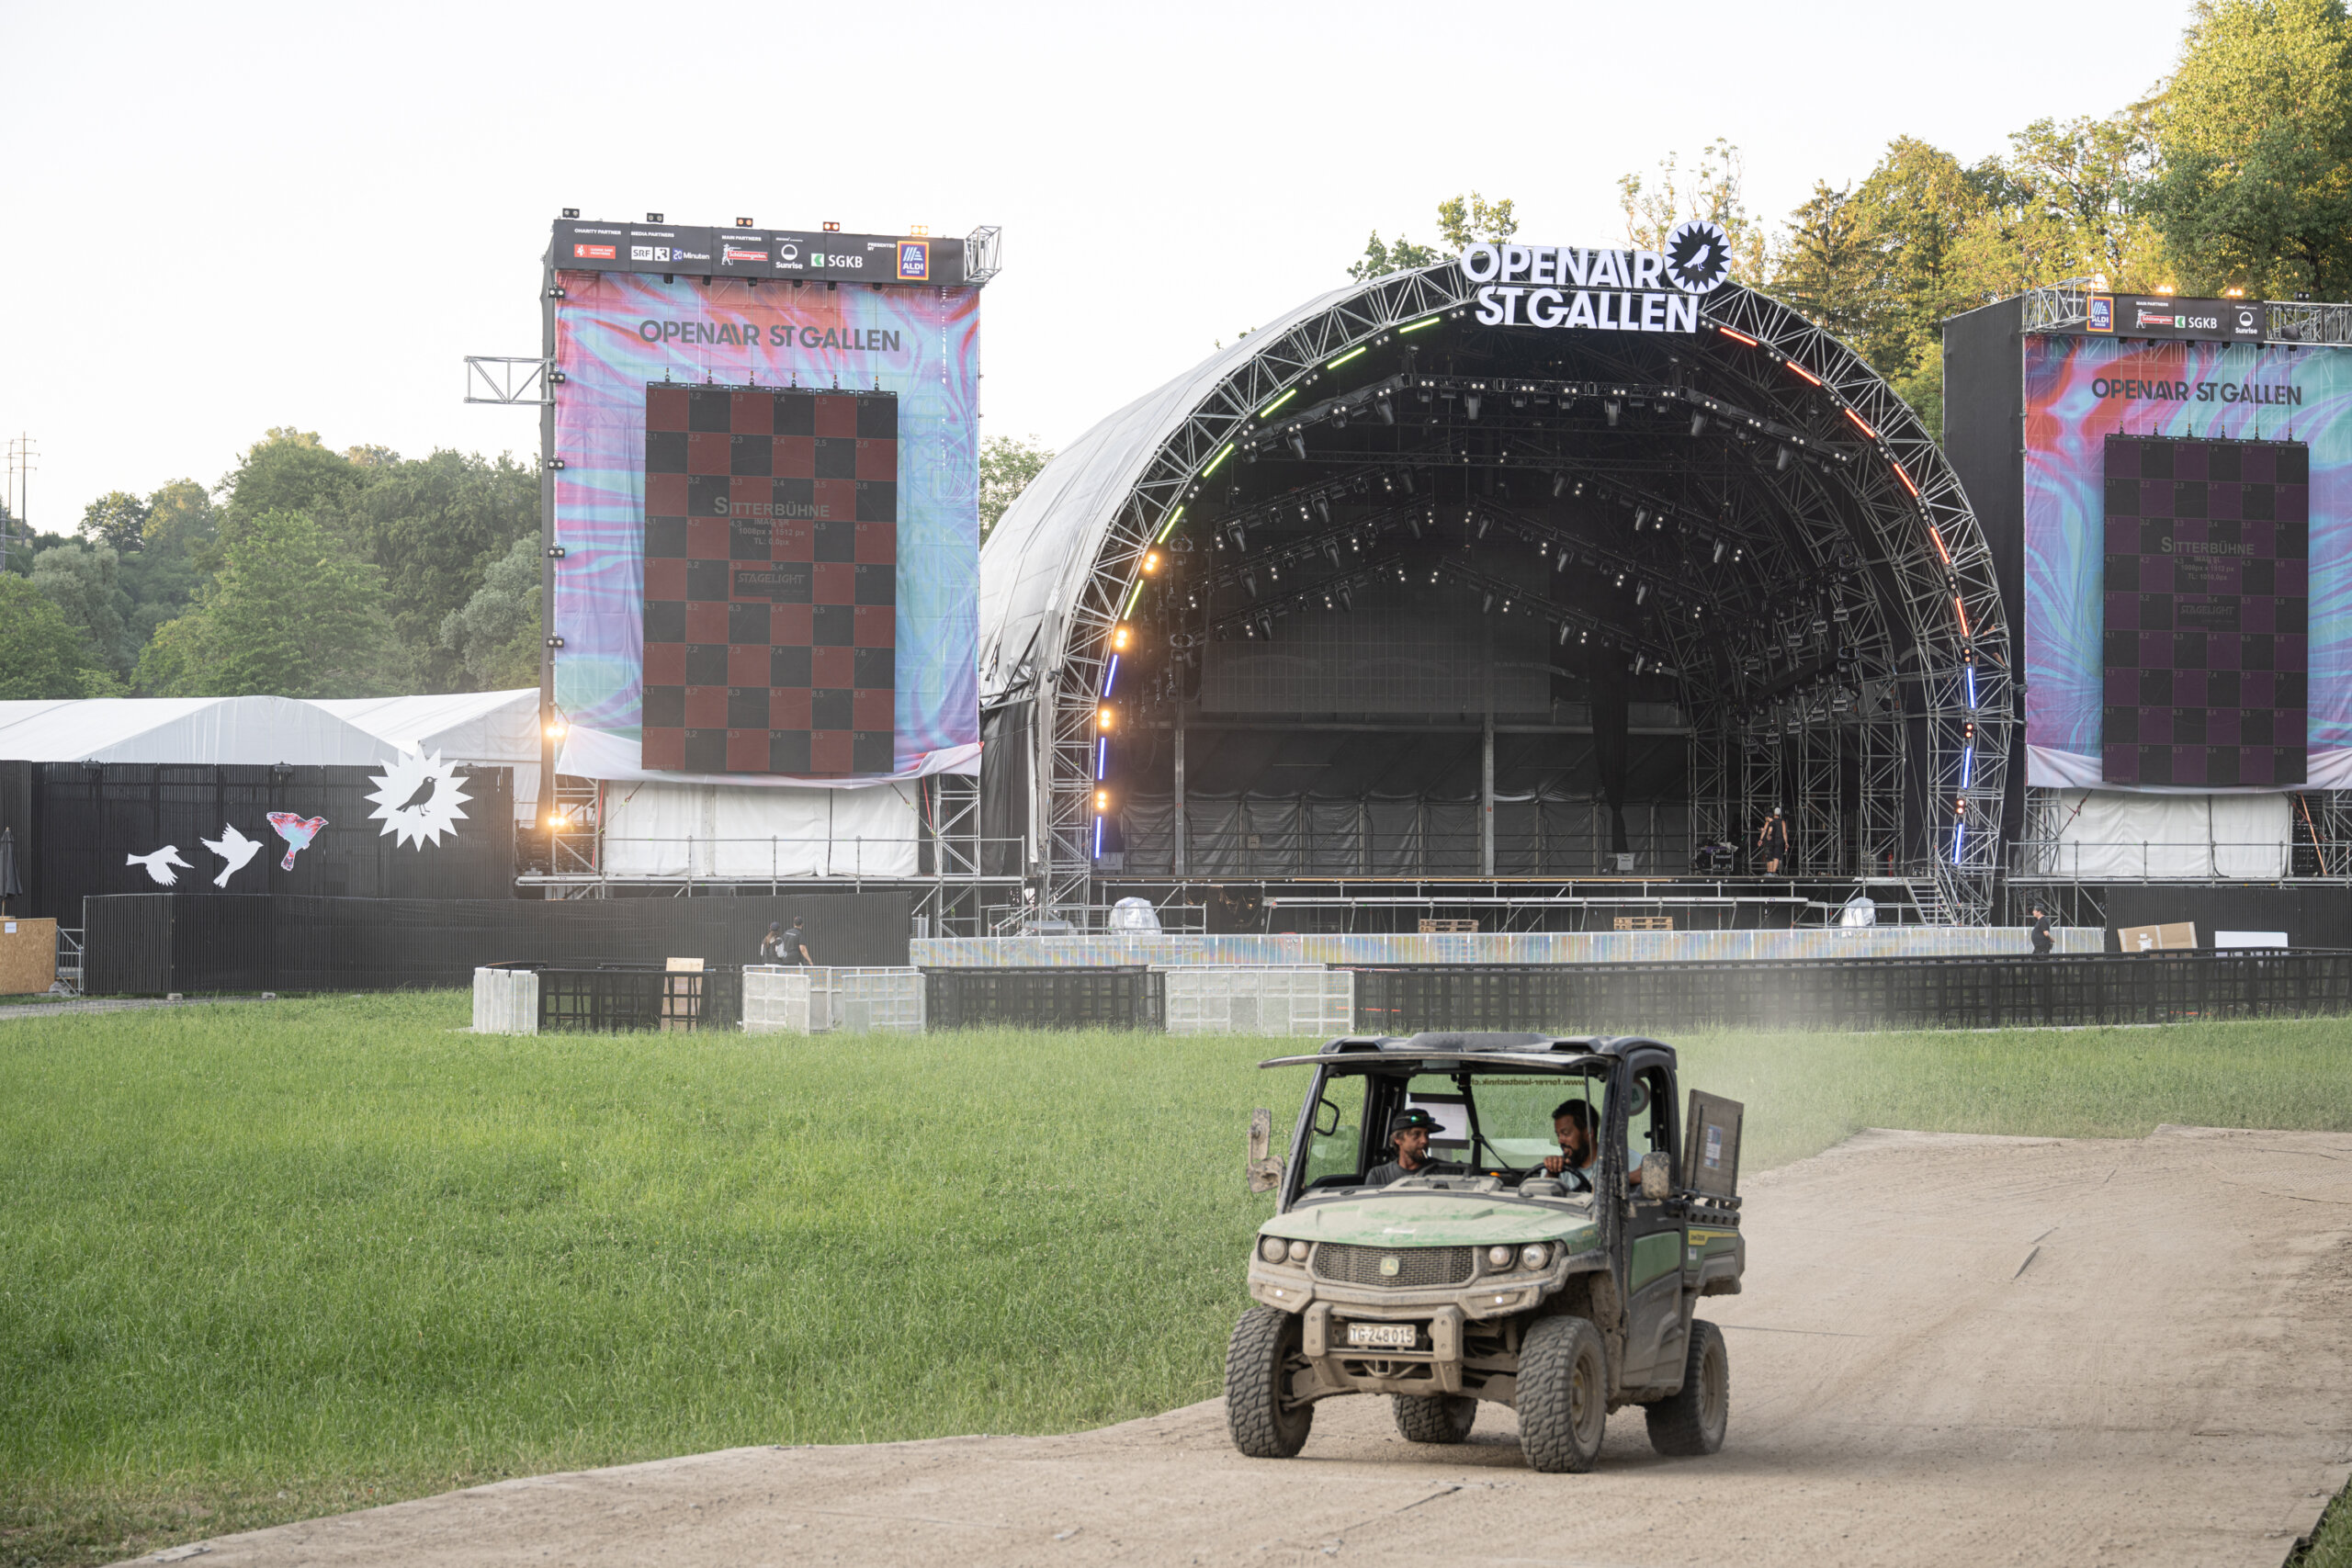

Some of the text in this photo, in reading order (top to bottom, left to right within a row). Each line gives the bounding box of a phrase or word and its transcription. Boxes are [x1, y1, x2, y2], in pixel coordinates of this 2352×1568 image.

[673, 250, 683, 259] 20
[829, 254, 863, 268] SGKB
[775, 261, 803, 269] Sunrise
[1461, 243, 1664, 288] OPENAIR
[1476, 287, 1698, 333] ST GALLEN
[2188, 317, 2217, 329] SGKB
[639, 320, 900, 351] OPENAIR ST GALLEN
[2091, 378, 2301, 405] OPENAIR ST GALLEN
[714, 496, 831, 517] SITTERBÜHNE
[739, 527, 766, 536] 1008px
[2161, 536, 2255, 555] SITTERBÜHNE
[738, 573, 806, 585] STAGELIGHT
[2180, 604, 2234, 615] STAGELIGHT
